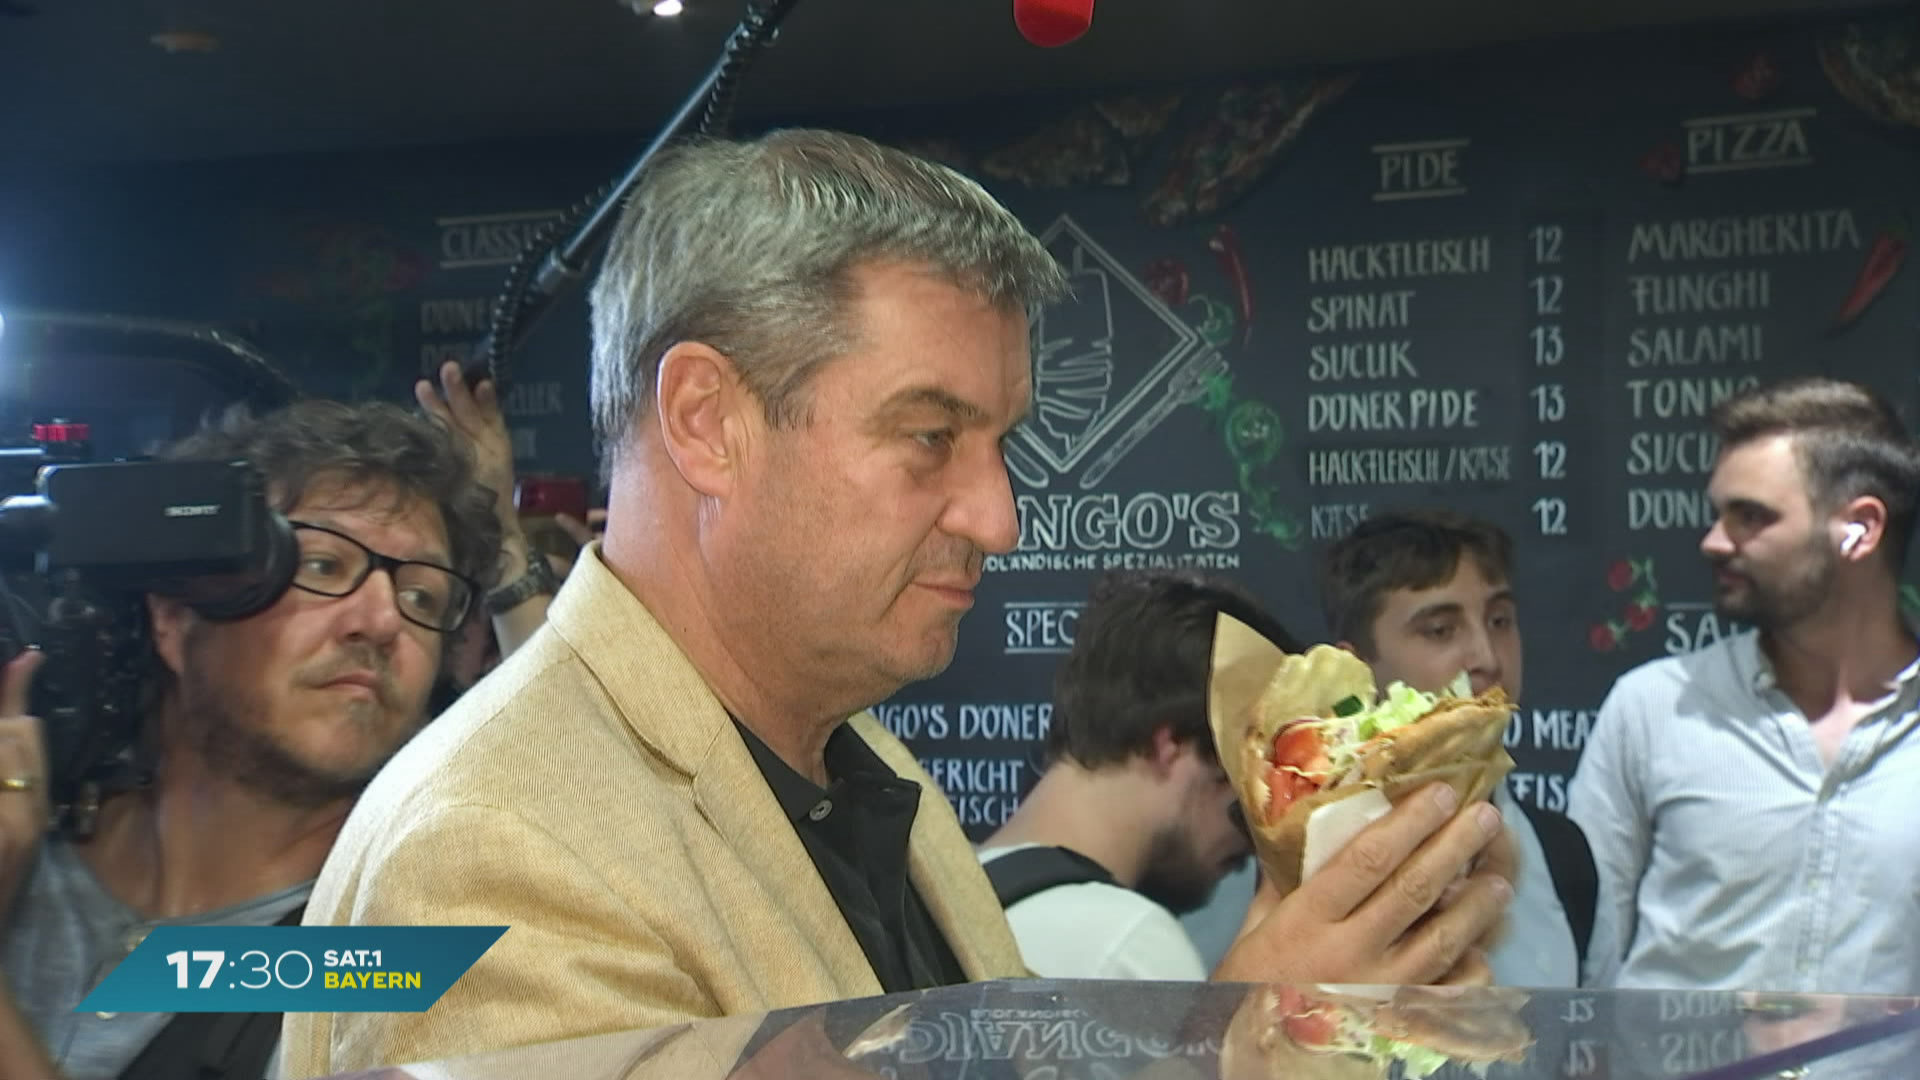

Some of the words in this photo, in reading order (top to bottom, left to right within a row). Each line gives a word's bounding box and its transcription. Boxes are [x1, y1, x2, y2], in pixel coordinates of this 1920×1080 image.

[1687, 118, 1809, 164] PIZZA
[1380, 149, 1460, 192] PIDE
[441, 221, 556, 260] CLASSI
[1528, 225, 1564, 263] 12
[1628, 209, 1860, 263] MARGHERITA
[1308, 236, 1491, 283] HACKFLEISCH
[1307, 290, 1416, 332] SPINAT
[1528, 275, 1564, 315] 12
[1629, 270, 1770, 315] FUNGHI
[1308, 341, 1420, 381] SUCUK
[1531, 325, 1565, 366] 13
[1627, 324, 1764, 368] SALAMI
[1410, 388, 1479, 430] PIDE
[1531, 383, 1567, 423] 13
[1533, 441, 1567, 479] 12
[1627, 430, 1720, 476] SUCU
[1016, 491, 1241, 551] NGO'S
[1532, 497, 1567, 535] 12
[1004, 608, 1080, 648] SPEC
[1664, 612, 1738, 655] SA
[950, 796, 1020, 826] ISCH
[1509, 773, 1568, 811] FIS
